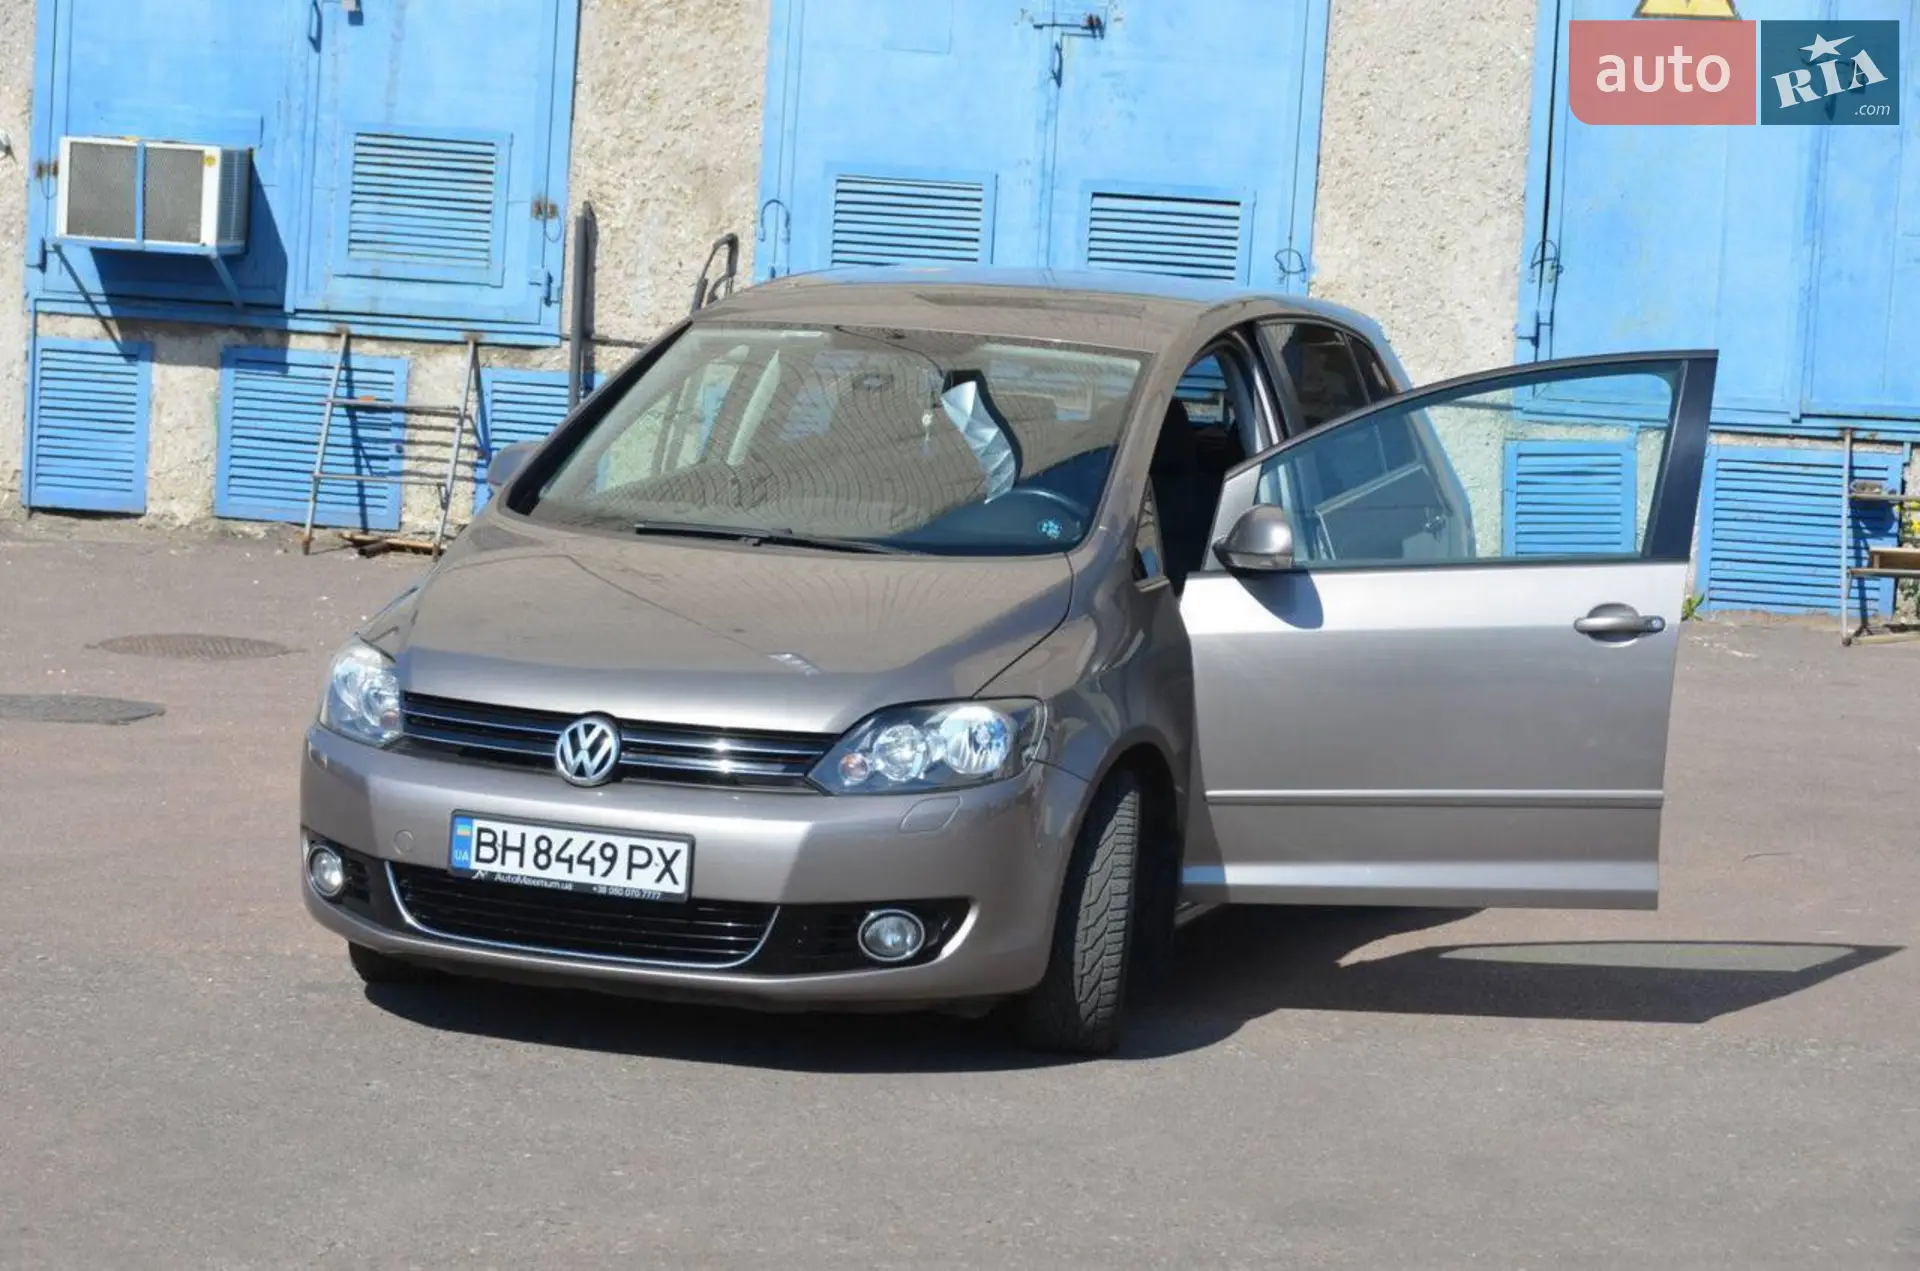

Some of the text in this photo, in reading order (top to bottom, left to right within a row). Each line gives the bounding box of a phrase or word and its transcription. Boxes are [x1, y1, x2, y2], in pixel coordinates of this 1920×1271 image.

[559, 719, 616, 781] VW
[455, 850, 469, 861] UA
[533, 835, 618, 878] 8449
